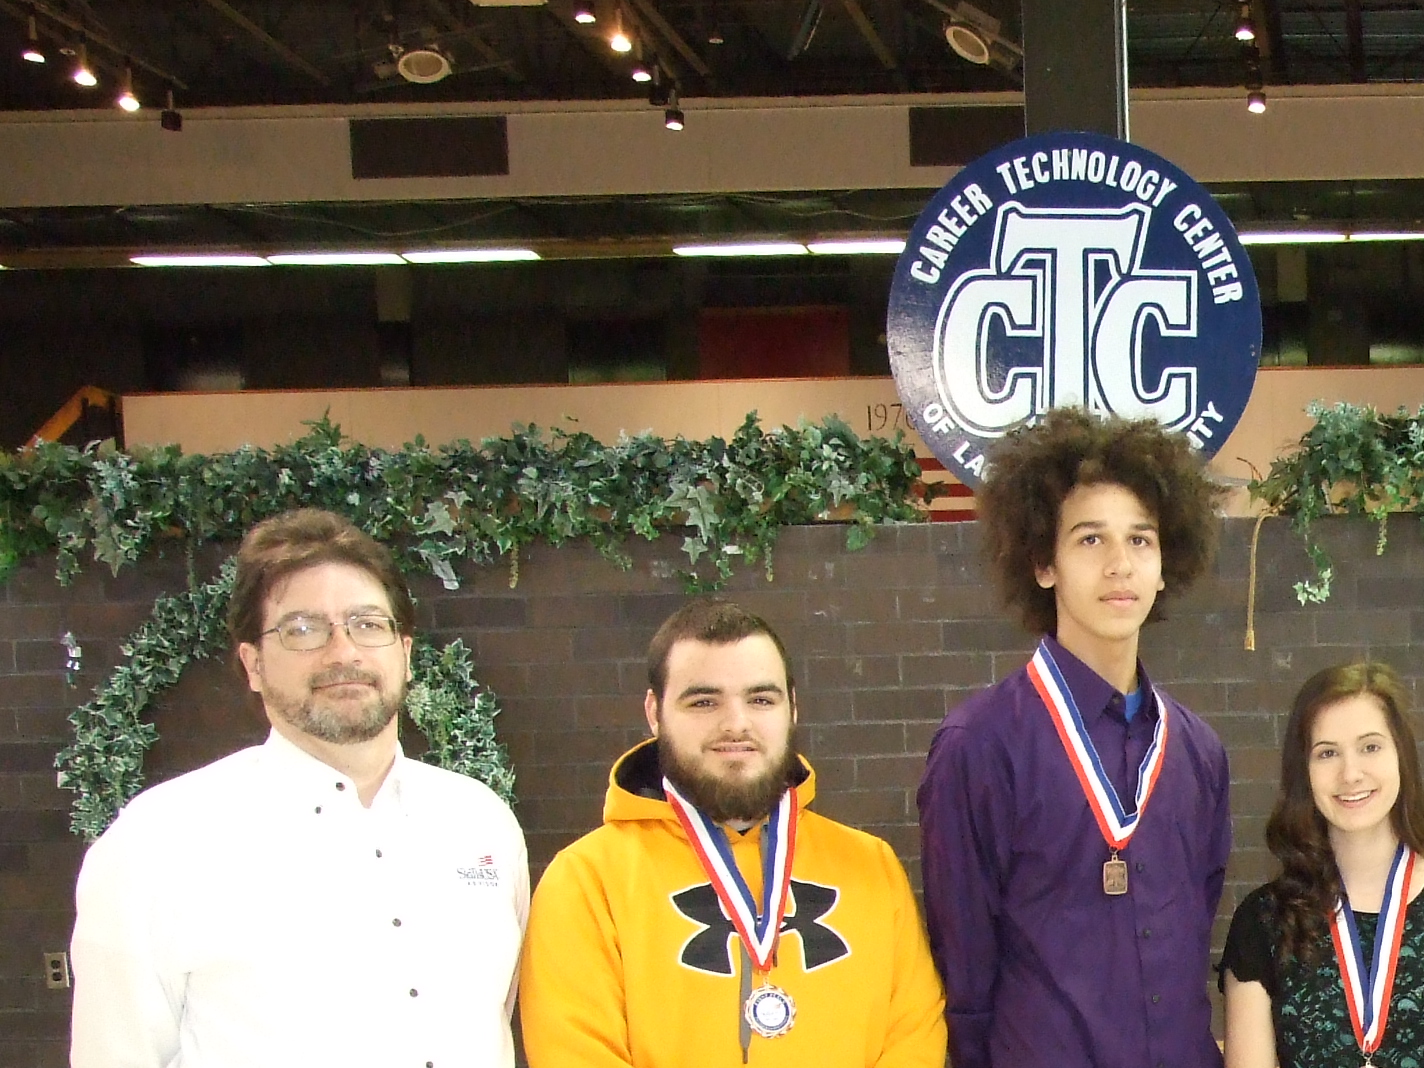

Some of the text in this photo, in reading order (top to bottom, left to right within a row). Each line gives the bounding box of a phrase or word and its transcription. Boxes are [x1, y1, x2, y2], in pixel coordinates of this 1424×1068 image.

[910, 148, 1243, 305] CAREER TECHNOLOGY CENTER
[922, 402, 955, 434] OF
